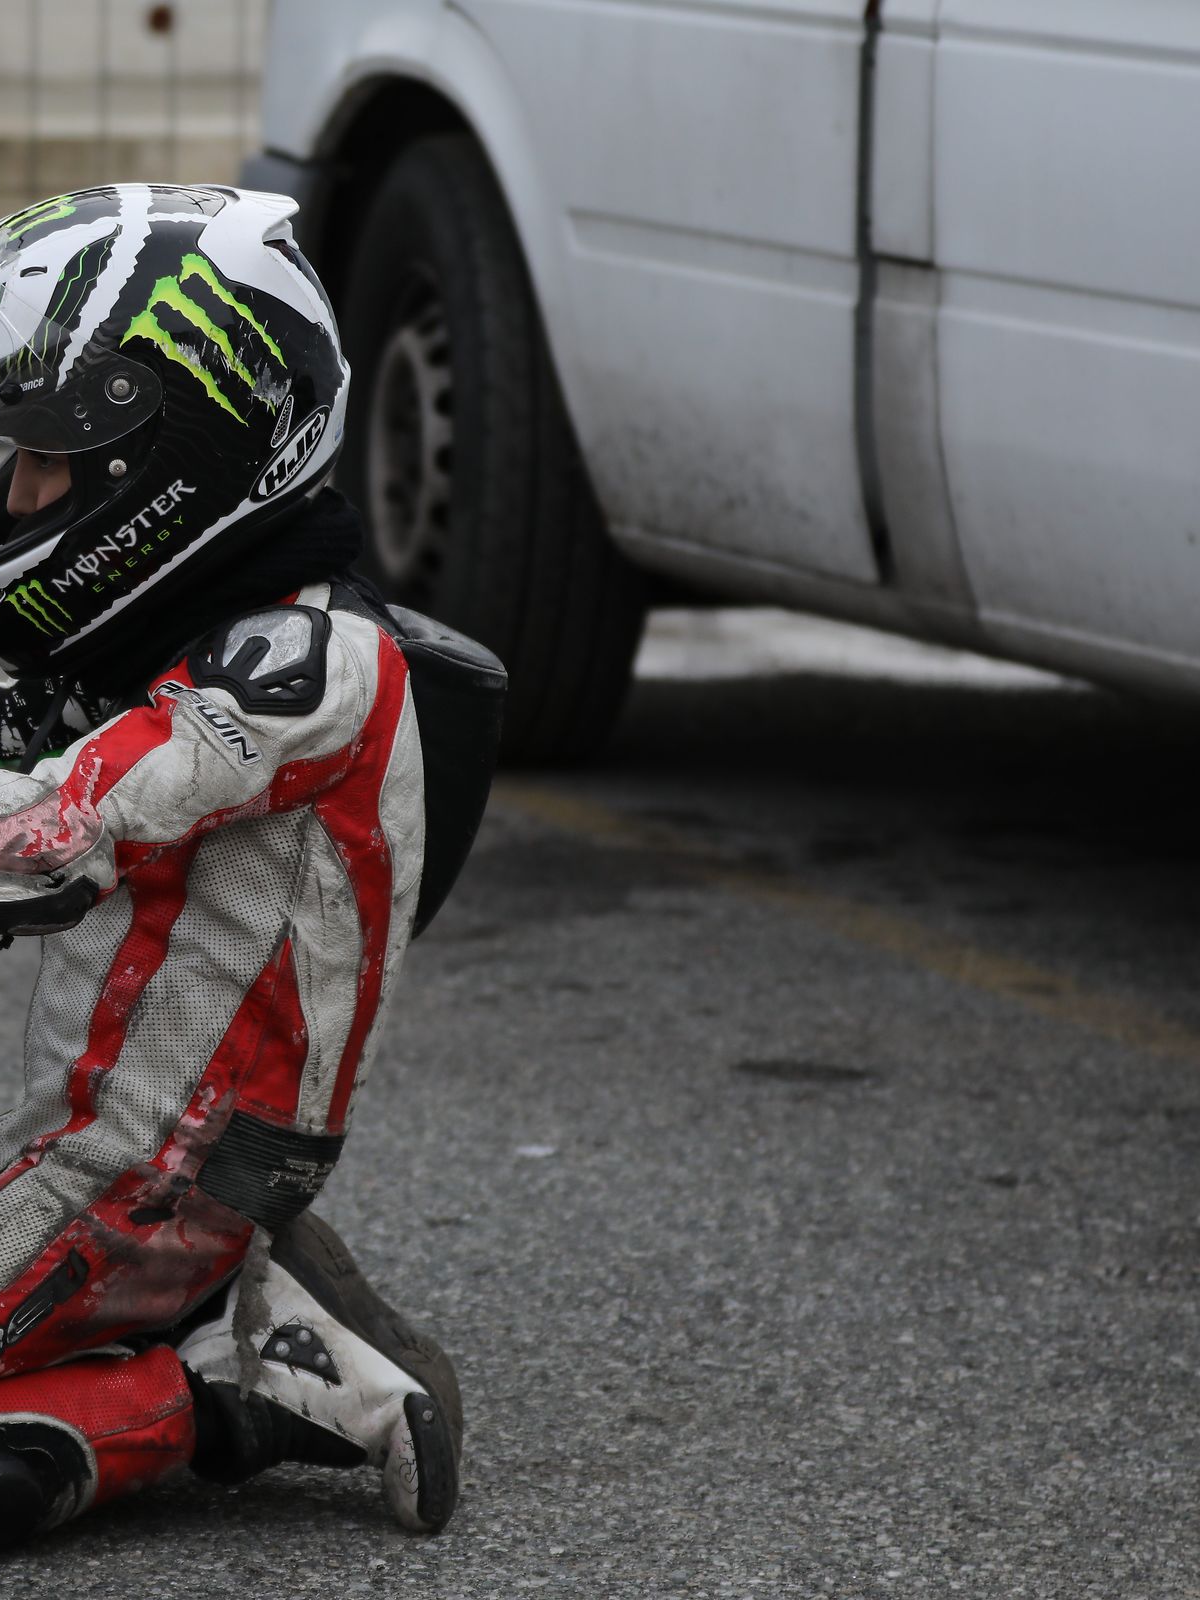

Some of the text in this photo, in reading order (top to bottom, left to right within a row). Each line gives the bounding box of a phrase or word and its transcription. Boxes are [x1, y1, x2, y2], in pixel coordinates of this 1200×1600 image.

[264, 412, 322, 497] HJC
[51, 479, 197, 594] MONSTER
[92, 515, 184, 593] ENERGY
